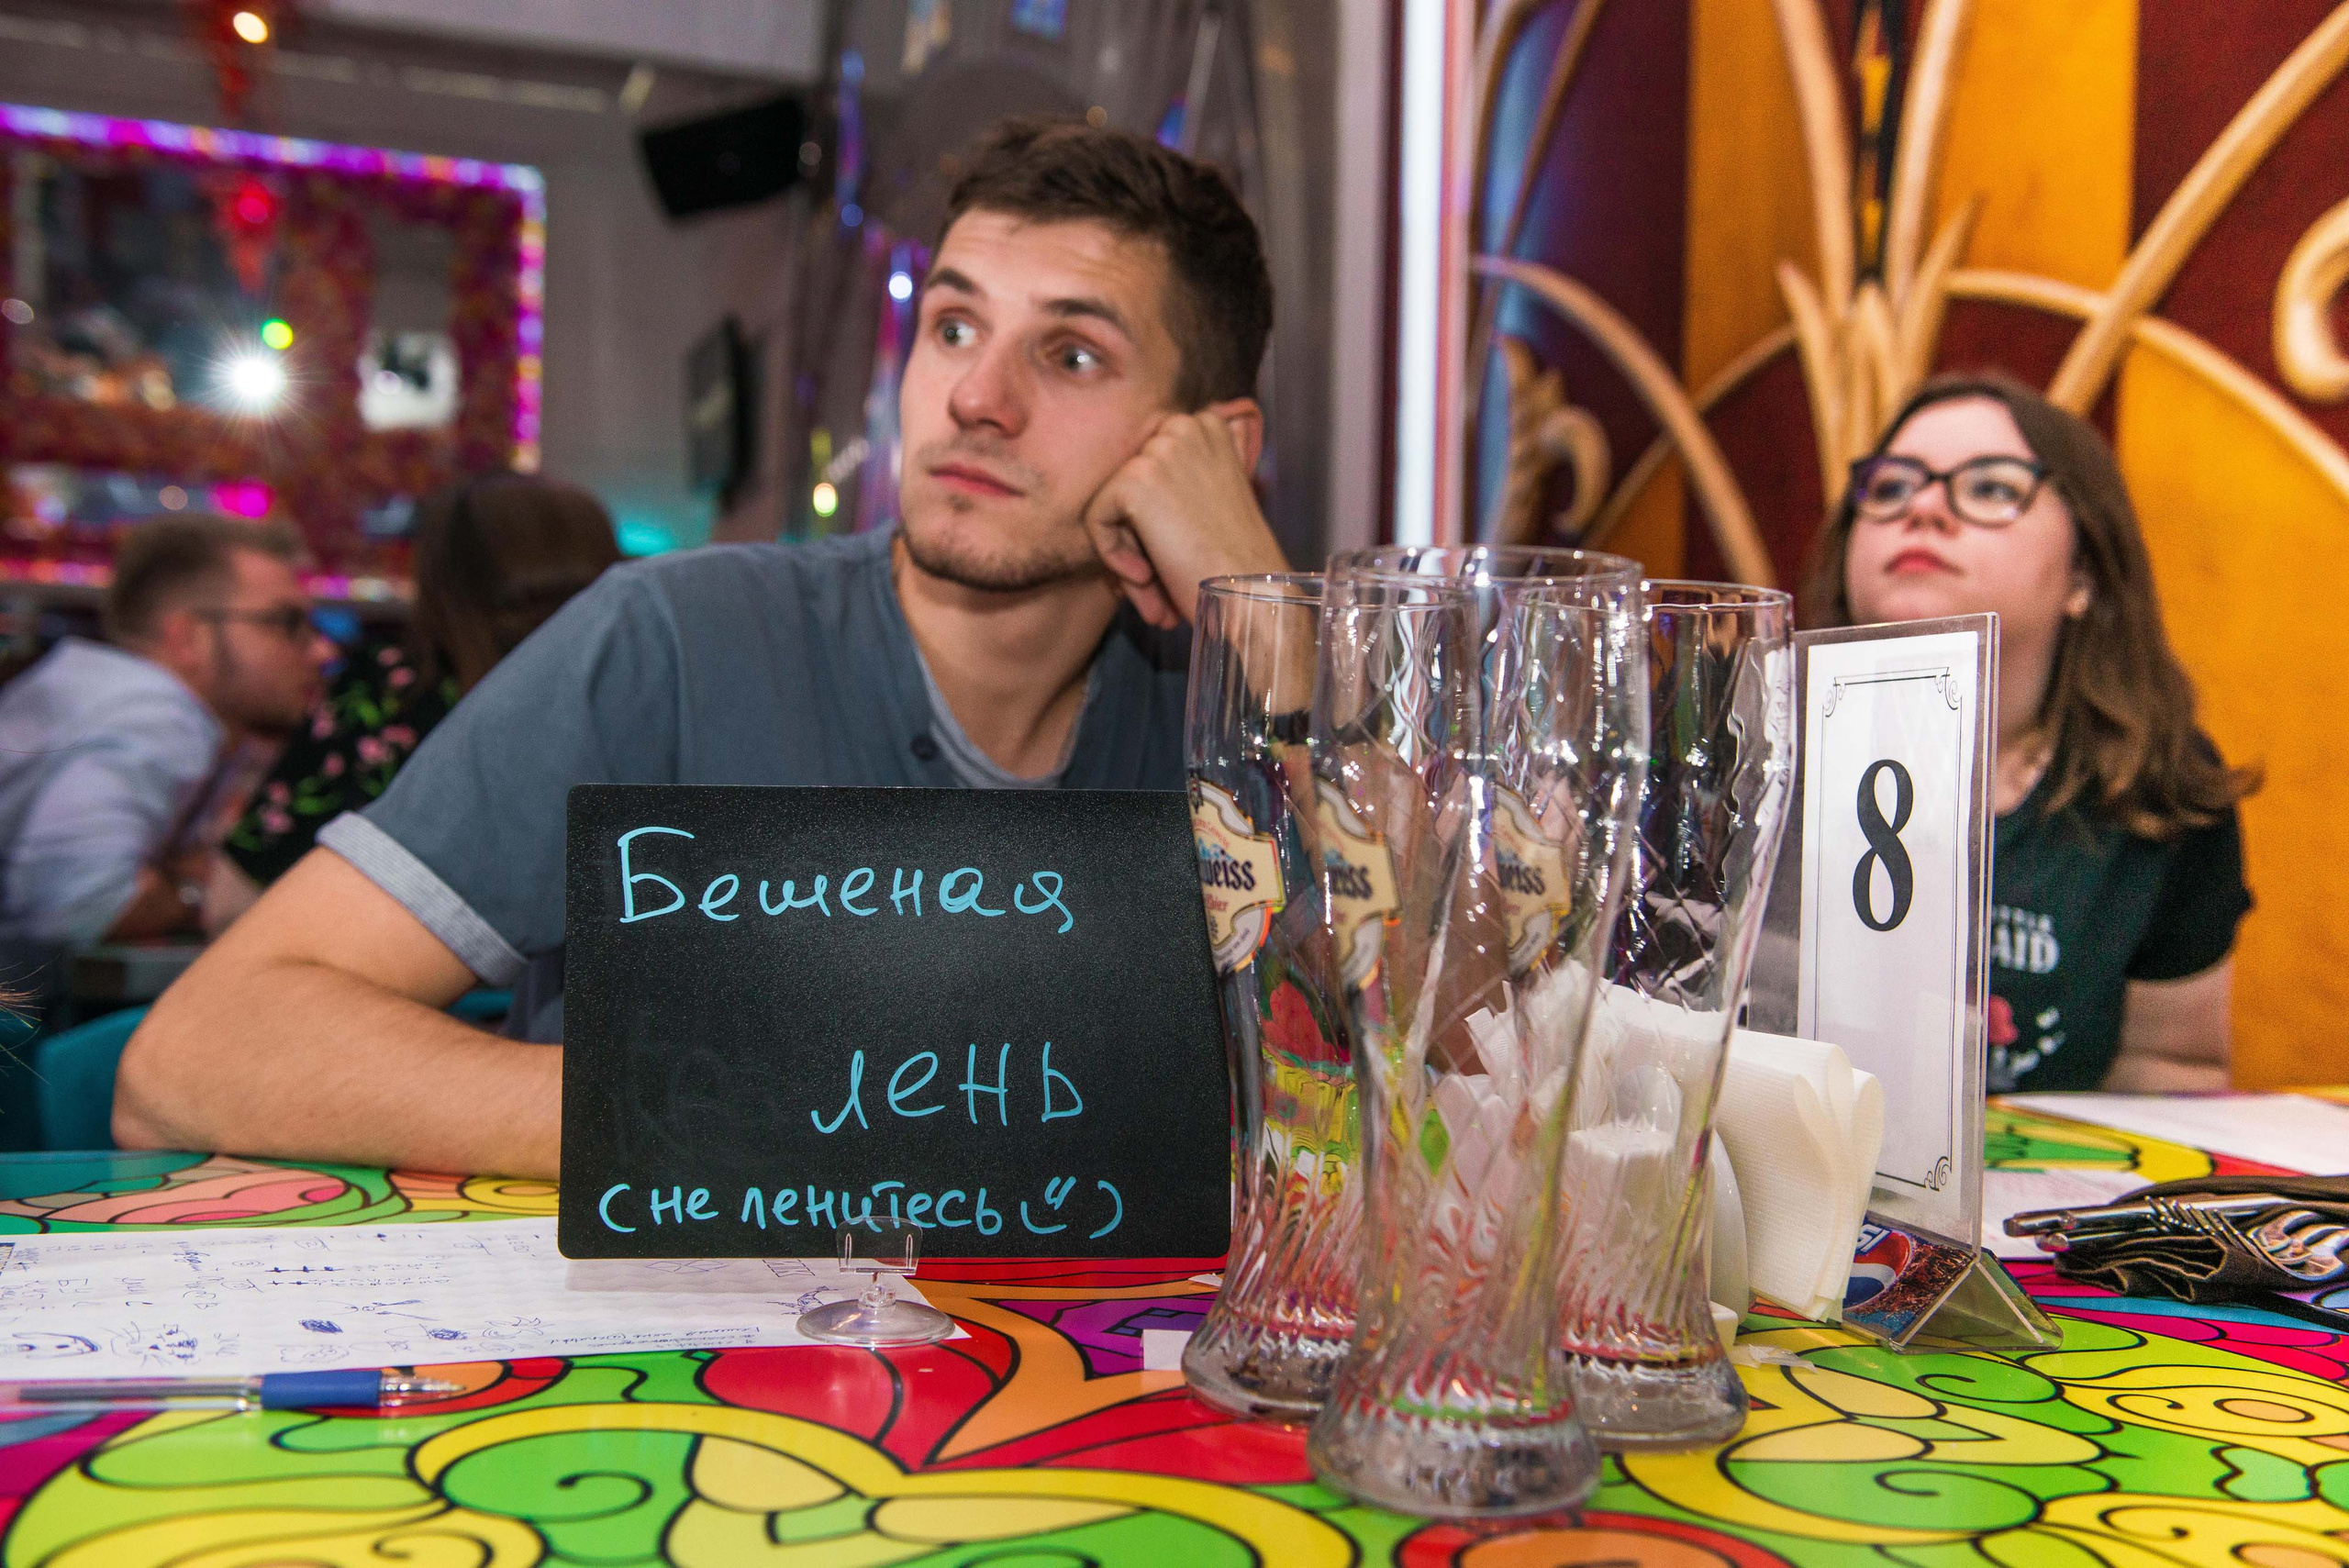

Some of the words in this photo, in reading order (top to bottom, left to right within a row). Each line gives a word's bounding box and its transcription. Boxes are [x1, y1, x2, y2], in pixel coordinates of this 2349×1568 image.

[617, 826, 1074, 934] Бешеная
[1853, 759, 1915, 932] 8
[740, 1180, 1004, 1236] ленитесь
